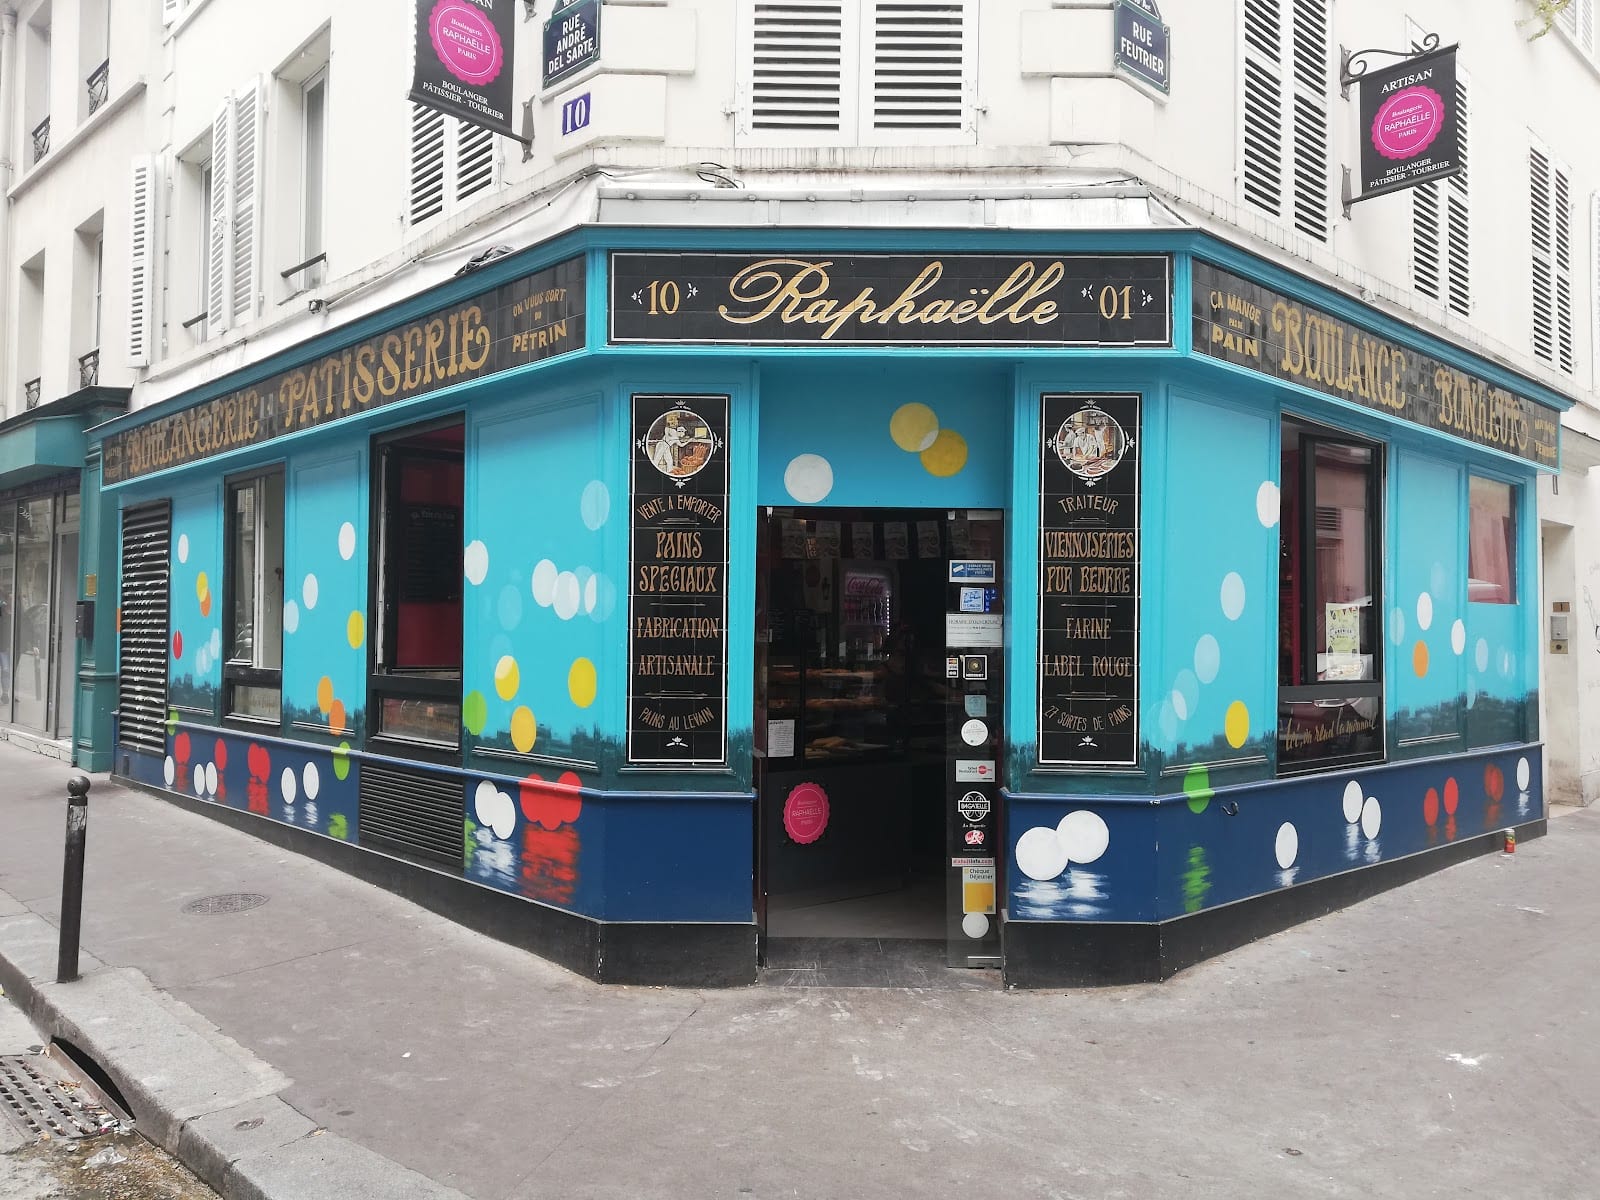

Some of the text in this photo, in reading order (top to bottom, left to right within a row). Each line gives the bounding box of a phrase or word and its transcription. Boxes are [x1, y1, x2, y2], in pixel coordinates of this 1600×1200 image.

[556, 22, 586, 54] ANDRÉ
[563, 13, 580, 36] RUE
[1132, 21, 1153, 47] RUE
[457, 47, 477, 60] PARIS
[548, 37, 594, 75] DEL SARTE
[1121, 36, 1164, 76] FEUTRIER
[441, 80, 488, 105] BOULANGER
[1381, 68, 1433, 94] ARTISAN
[422, 81, 463, 105] PÂTISSIER
[468, 100, 504, 121] TOURRIER
[1391, 104, 1423, 118] Boulangerie
[566, 101, 586, 133] 10
[1398, 128, 1417, 139] PARIS
[1370, 172, 1407, 188] PÂTISSIER
[1411, 160, 1450, 177] TOURRIER
[1386, 158, 1432, 176] BOULANGER
[513, 288, 567, 317] ON VOUS SORT
[646, 280, 680, 315] 10
[719, 258, 1065, 339] Raphaëlle
[1099, 285, 1133, 320] 01
[1210, 291, 1261, 326] ÇA MANGE
[512, 318, 567, 353] PÉTRIN
[1211, 323, 1259, 357] PAIN
[1271, 301, 1407, 409] BOULANGE
[126, 305, 491, 473] BOULANGERIE PATISSERIE
[637, 497, 666, 521] VENTE
[677, 494, 722, 523] EMPORTER
[1058, 495, 1119, 515] TRAITEUR
[655, 531, 703, 559] PAINS
[1045, 531, 1134, 559] VIENNOISERIES
[1046, 565, 1131, 594] PUR BEURRE
[636, 616, 721, 639] FABRICATION
[1065, 617, 1112, 640] FARINE
[638, 654, 716, 676] ARTISANALE
[1044, 654, 1133, 678] LABEL ROUGE
[638, 706, 715, 731] PAINS AU LEVAIN
[1057, 711, 1088, 731] SORTES
[1093, 715, 1105, 731] DE
[1108, 704, 1133, 727] PAINS
[960, 802, 988, 810] BAGATELLE
